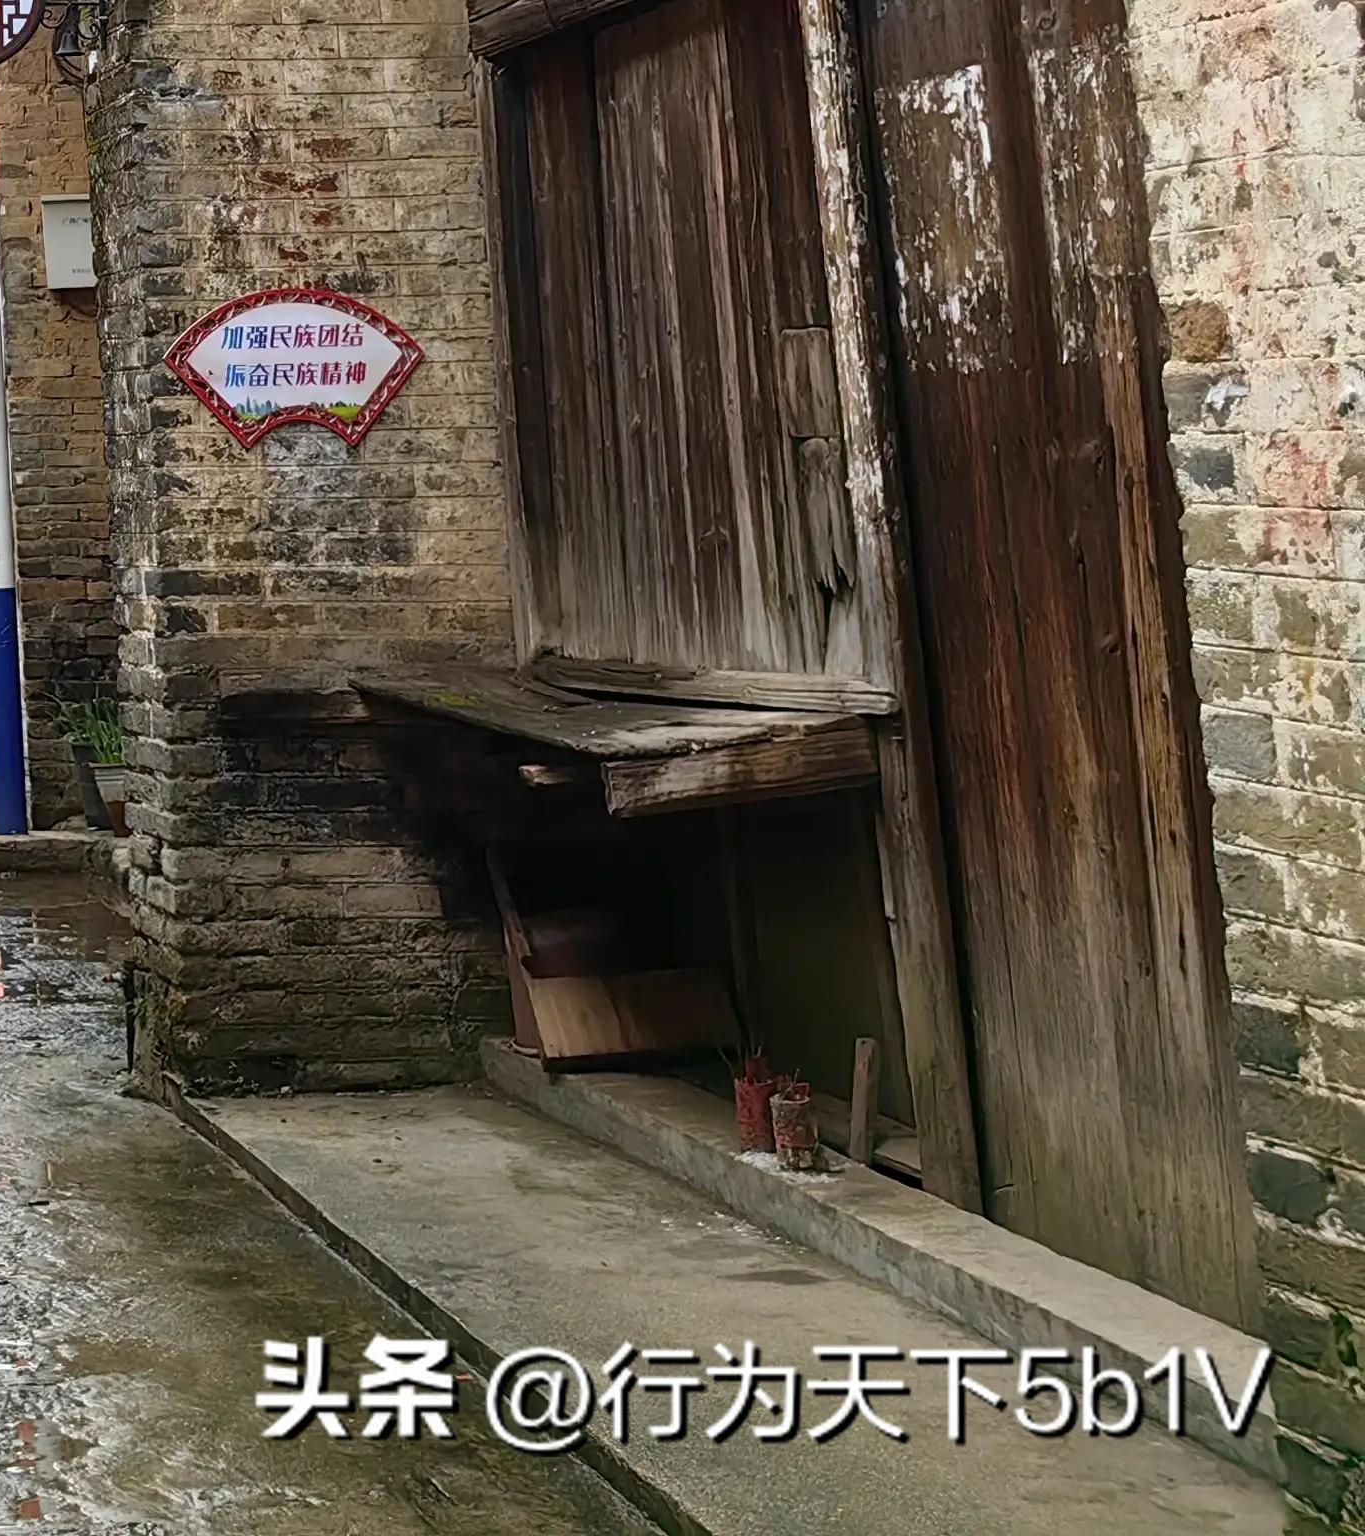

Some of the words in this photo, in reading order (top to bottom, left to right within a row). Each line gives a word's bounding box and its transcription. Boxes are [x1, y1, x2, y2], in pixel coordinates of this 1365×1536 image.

[221, 323, 365, 350] 加强民族团结
[224, 360, 367, 388] 振奋民族精神
